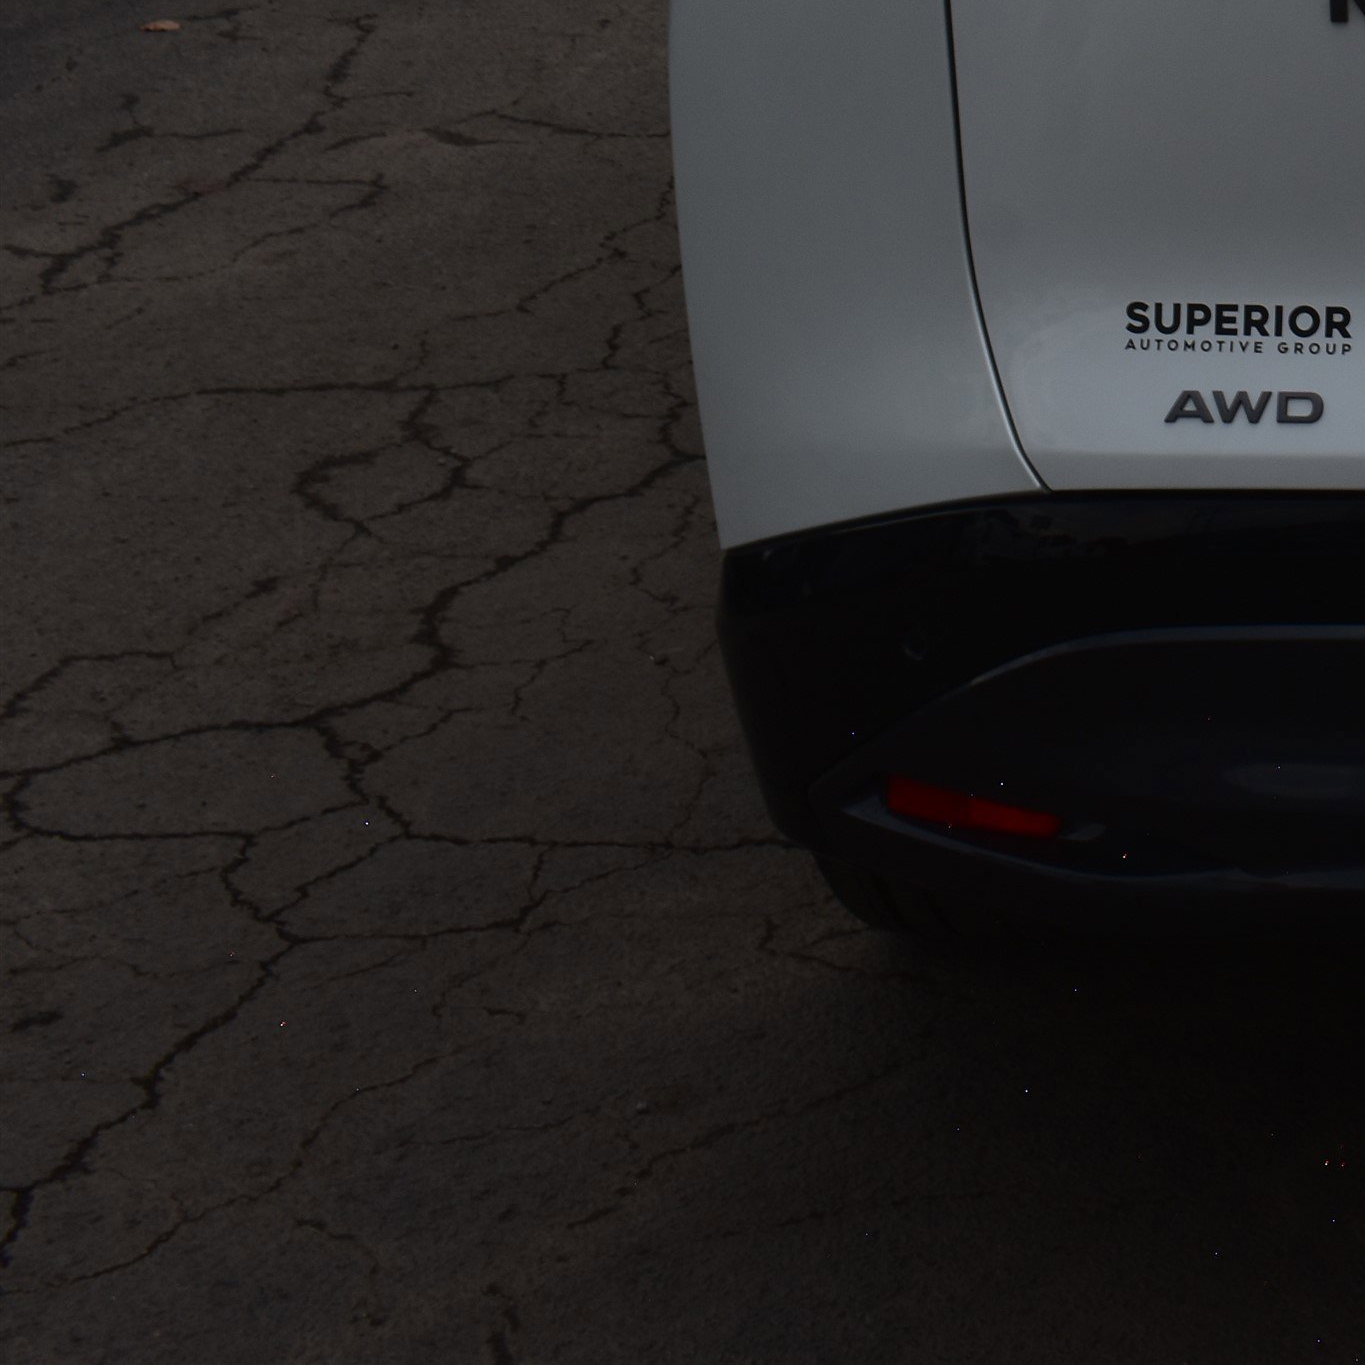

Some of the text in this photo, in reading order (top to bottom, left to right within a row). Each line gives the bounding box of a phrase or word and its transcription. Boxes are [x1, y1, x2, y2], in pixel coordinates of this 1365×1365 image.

[1125, 300, 1352, 339] SUPERIOR
[1125, 338, 1352, 356] AUTOMOTIVE GROUP
[1164, 389, 1325, 424] AWD
